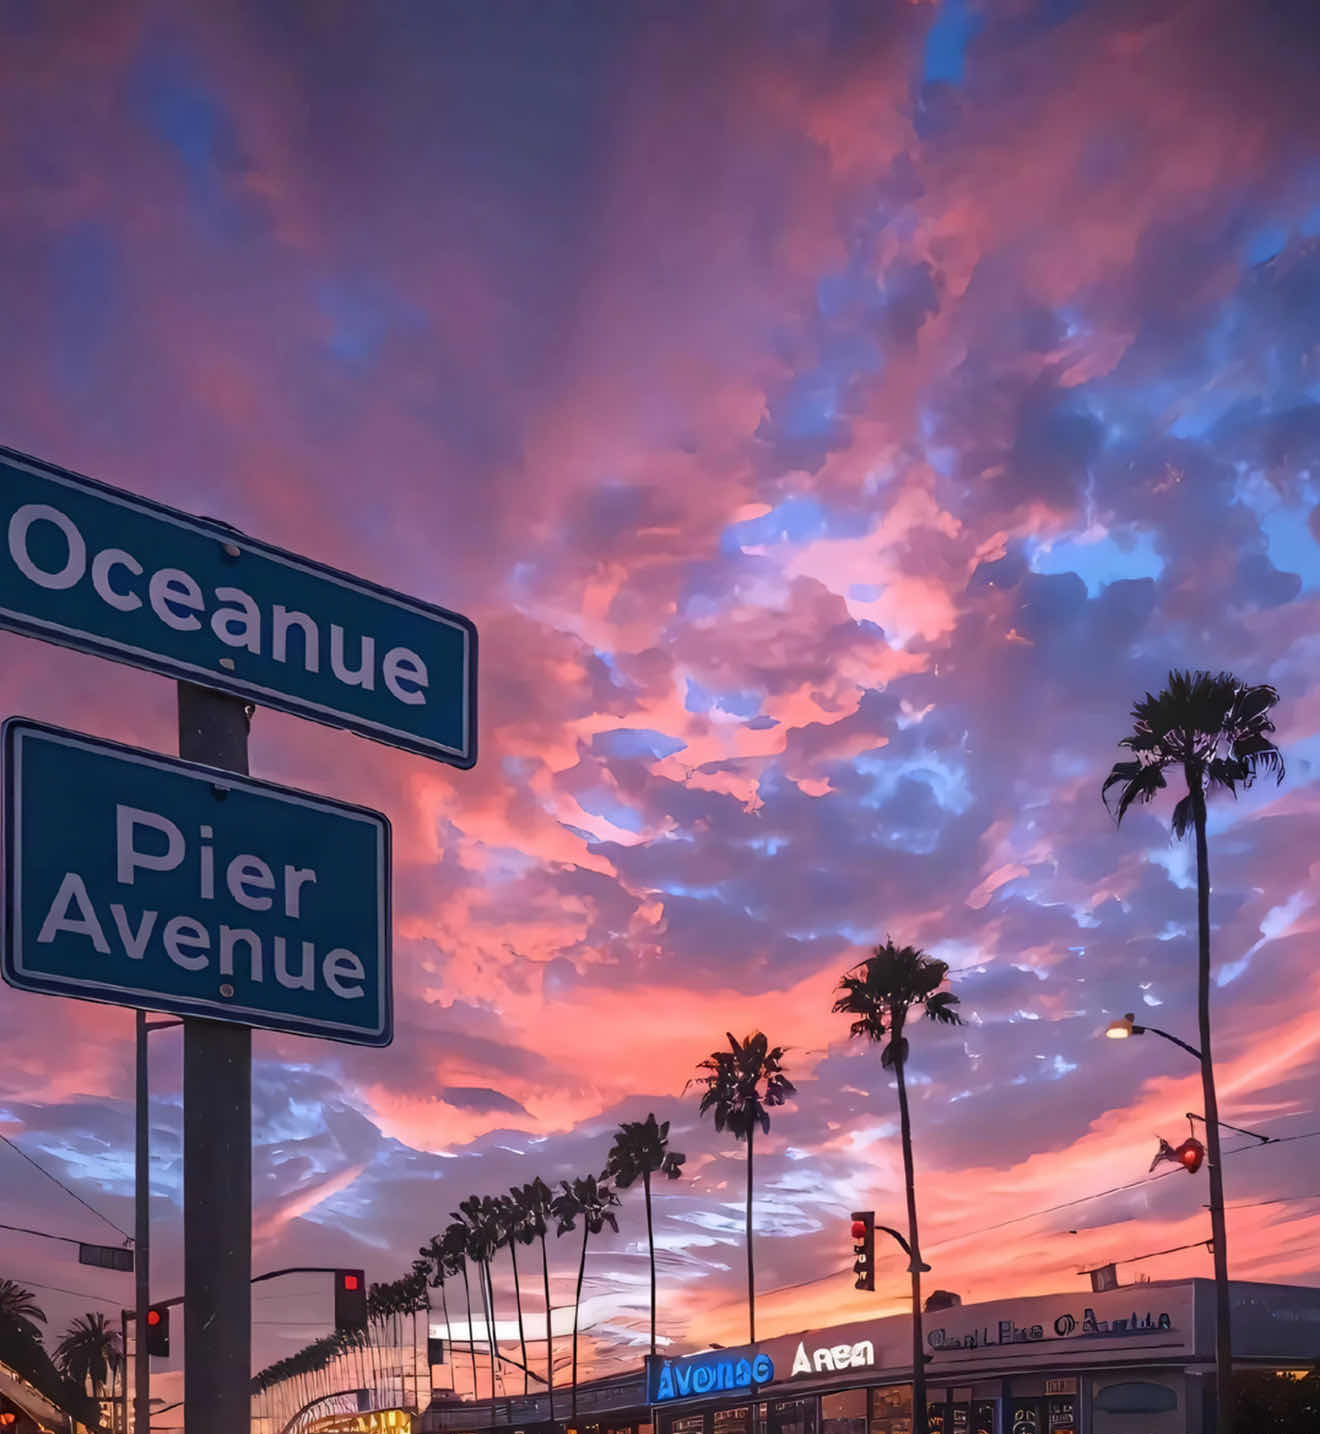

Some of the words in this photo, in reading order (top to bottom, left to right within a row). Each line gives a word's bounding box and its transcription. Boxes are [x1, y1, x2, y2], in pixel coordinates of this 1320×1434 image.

[8, 504, 430, 705] Oceanue
[115, 804, 316, 919] Pier
[37, 872, 365, 998] Avenue
